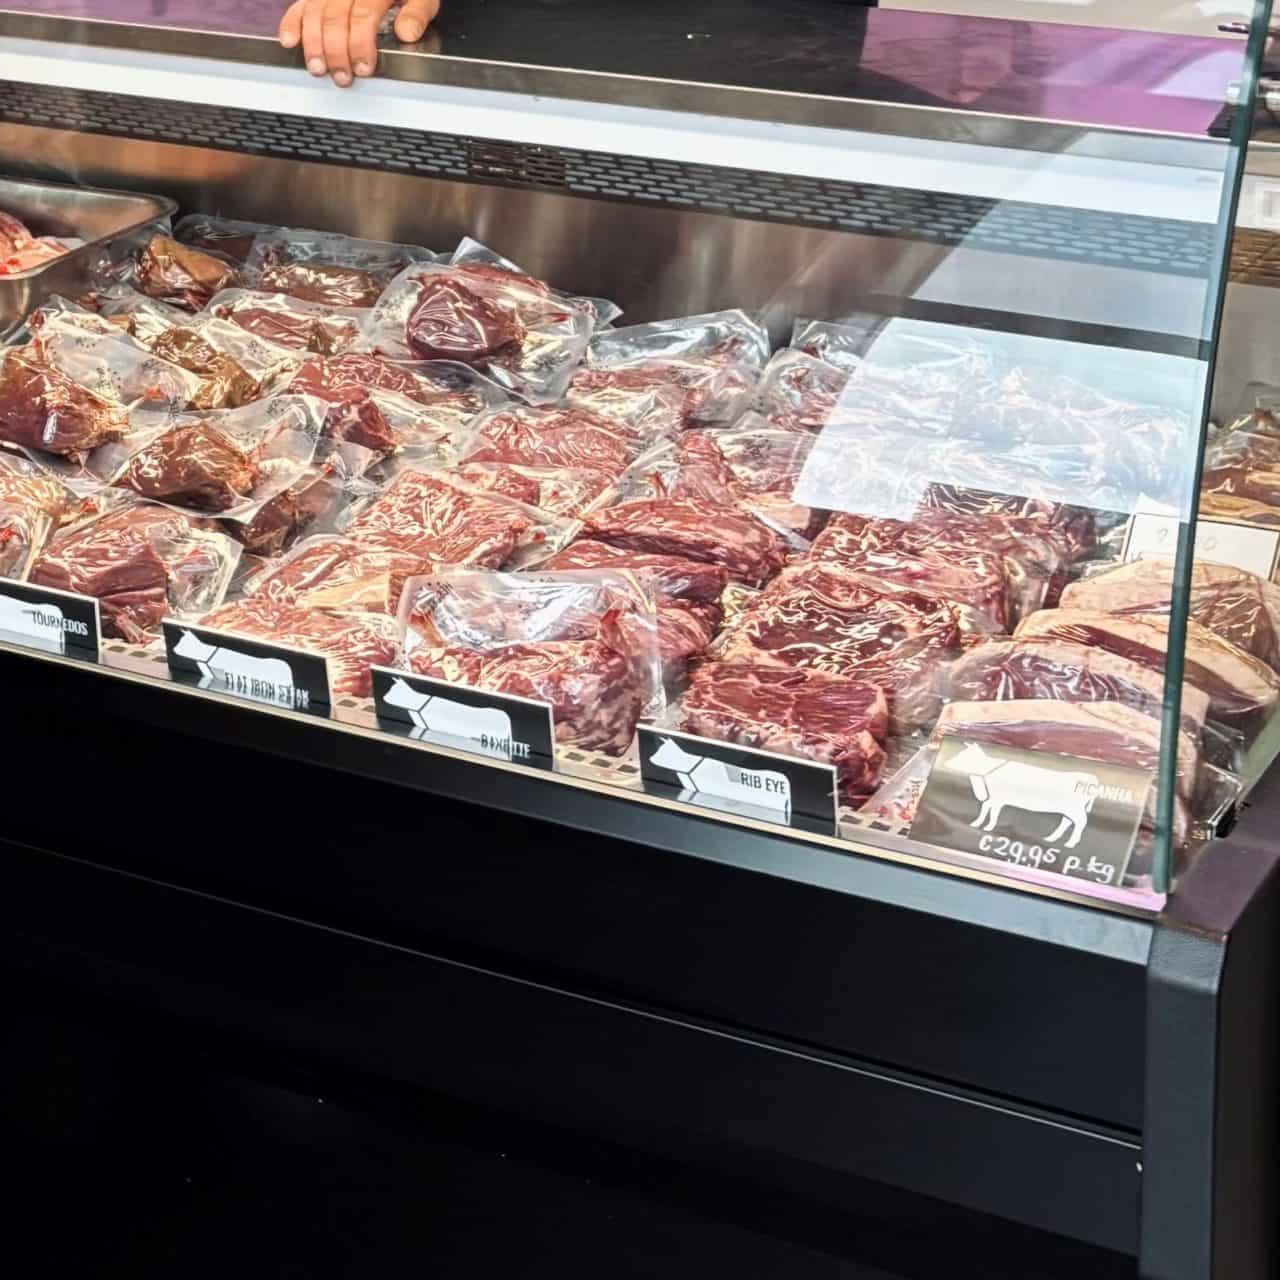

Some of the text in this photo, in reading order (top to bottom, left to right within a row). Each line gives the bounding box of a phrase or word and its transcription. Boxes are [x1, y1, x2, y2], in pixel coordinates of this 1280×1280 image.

[32, 610, 89, 636] TOURNEDOS
[740, 772, 786, 794] RIB EYE
